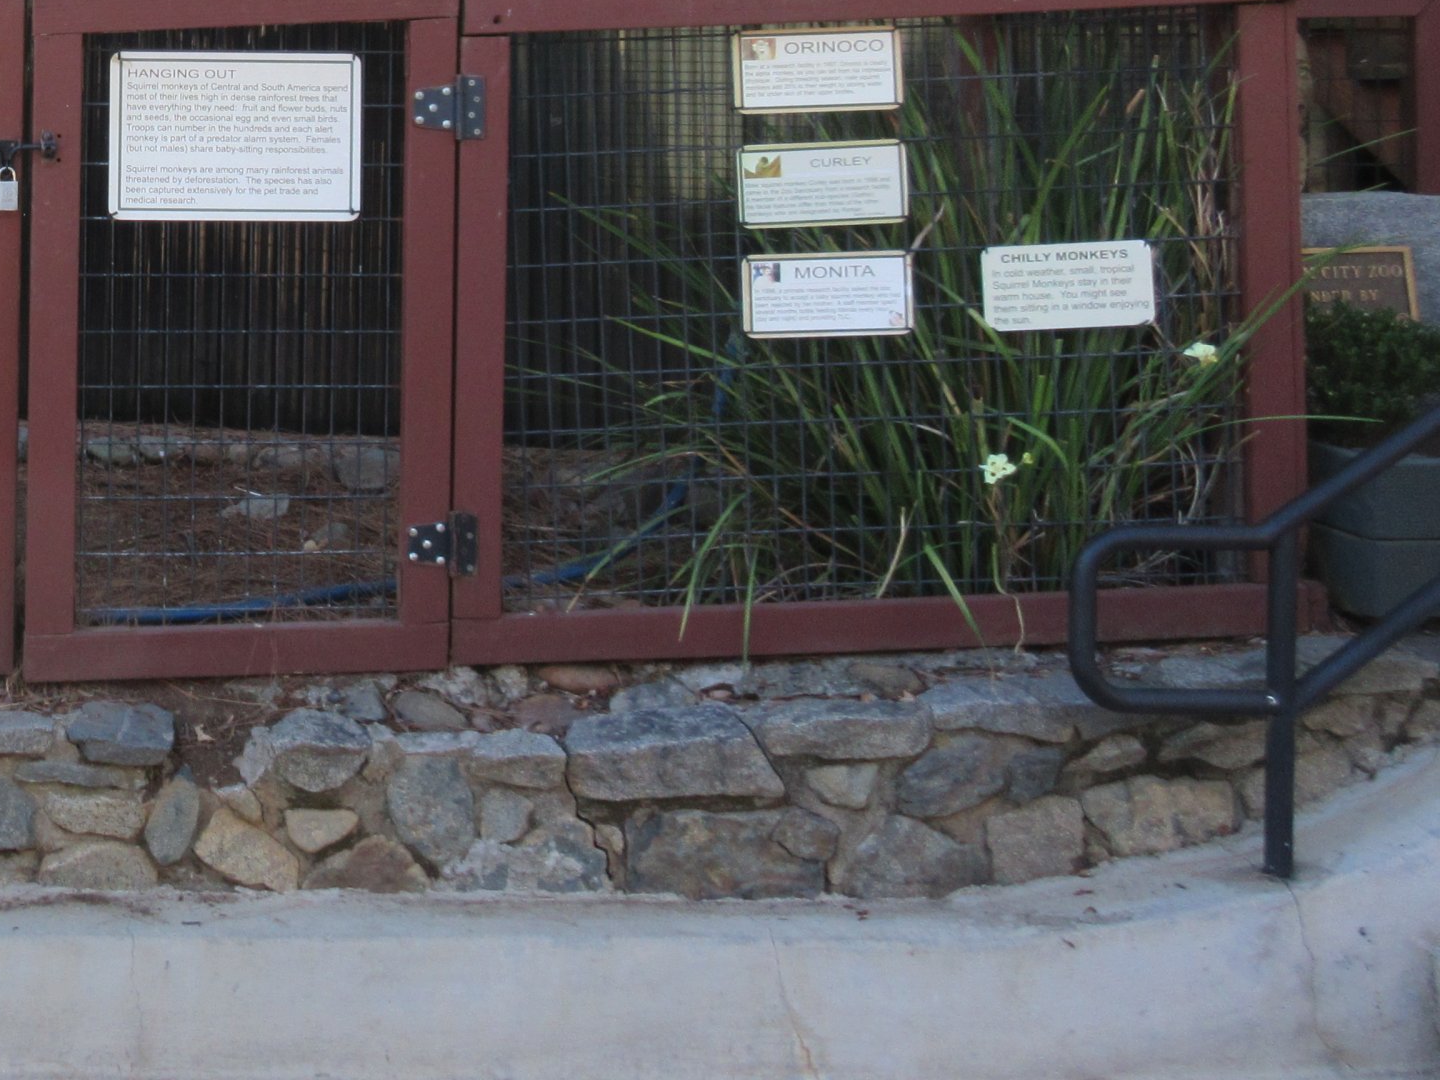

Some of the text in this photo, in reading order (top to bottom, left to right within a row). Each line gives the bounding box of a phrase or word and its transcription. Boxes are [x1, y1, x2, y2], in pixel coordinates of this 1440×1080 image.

[784, 38, 884, 55] ORINOCO
[127, 69, 237, 79] HANGING OUT
[127, 82, 158, 92] Squirrel
[161, 82, 198, 93] monkeys
[210, 83, 240, 91] Central
[242, 83, 258, 91] and
[261, 83, 285, 91] South
[287, 83, 320, 92] America
[322, 84, 348, 94] spend
[127, 92, 147, 101] most
[159, 93, 176, 101] their
[179, 93, 198, 101] lives
[200, 93, 218, 103] high
[230, 93, 255, 101] dense
[258, 93, 296, 102] rainforest
[298, 93, 319, 102] trees
[321, 94, 337, 102] that
[127, 103, 147, 111] have
[148, 103, 191, 113] everything
[194, 103, 211, 113] they
[242, 103, 257, 112] fruit
[260, 104, 275, 112] and
[278, 104, 302, 112] flower
[329, 104, 347, 112] nuts
[127, 113, 142, 121] and
[144, 113, 171, 122] seeds,
[173, 113, 187, 121] the
[189, 113, 233, 121] occasional
[235, 115, 251, 124] egg
[253, 114, 269, 122] and
[293, 114, 315, 122] small
[127, 124, 154, 134] Troops
[174, 124, 205, 132] number
[218, 124, 231, 132] the
[233, 124, 272, 132] hundreds
[274, 124, 290, 132] and
[292, 124, 312, 132] each
[314, 124, 333, 133] alert
[126, 134, 158, 144] monkey
[169, 134, 186, 144] part
[206, 134, 240, 145] predator
[243, 135, 266, 143] alarm
[268, 135, 298, 145] system.
[305, 135, 341, 143] Females
[126, 144, 142, 154] (but
[144, 144, 157, 152] not
[159, 144, 187, 154] males)
[189, 144, 213, 152] share
[215, 144, 263, 155] baby-sitting
[809, 155, 872, 168] CURLEY
[126, 165, 157, 175] Squirrel
[159, 165, 197, 175] monkeys
[215, 167, 244, 176] among
[245, 167, 268, 176] many
[271, 166, 310, 174] rainforest
[311, 166, 343, 174] animals
[126, 175, 170, 183] threatened
[172, 175, 182, 185] by
[246, 176, 261, 184] The
[264, 176, 295, 186] species
[297, 176, 312, 184] has
[314, 176, 332, 184] also
[126, 185, 318, 196] been captured extensively for the pet trade and
[126, 195, 157, 204] medical
[1001, 249, 1129, 263] CHILLY MONKEYS
[794, 264, 876, 279] MONITA
[1003, 269, 1023, 277] cold
[1099, 265, 1135, 276] tropical
[992, 279, 1029, 291] Squirrel
[1032, 278, 1074, 290] Monkeys
[1077, 277, 1097, 288] stay
[1111, 276, 1133, 285] their
[1061, 290, 1078, 298] You
[1080, 289, 1107, 300] might
[994, 304, 1017, 313] them
[1020, 302, 1048, 314] sitting
[1071, 300, 1106, 309] window
[1109, 298, 1149, 310] enjoying
[994, 316, 1009, 324] the
